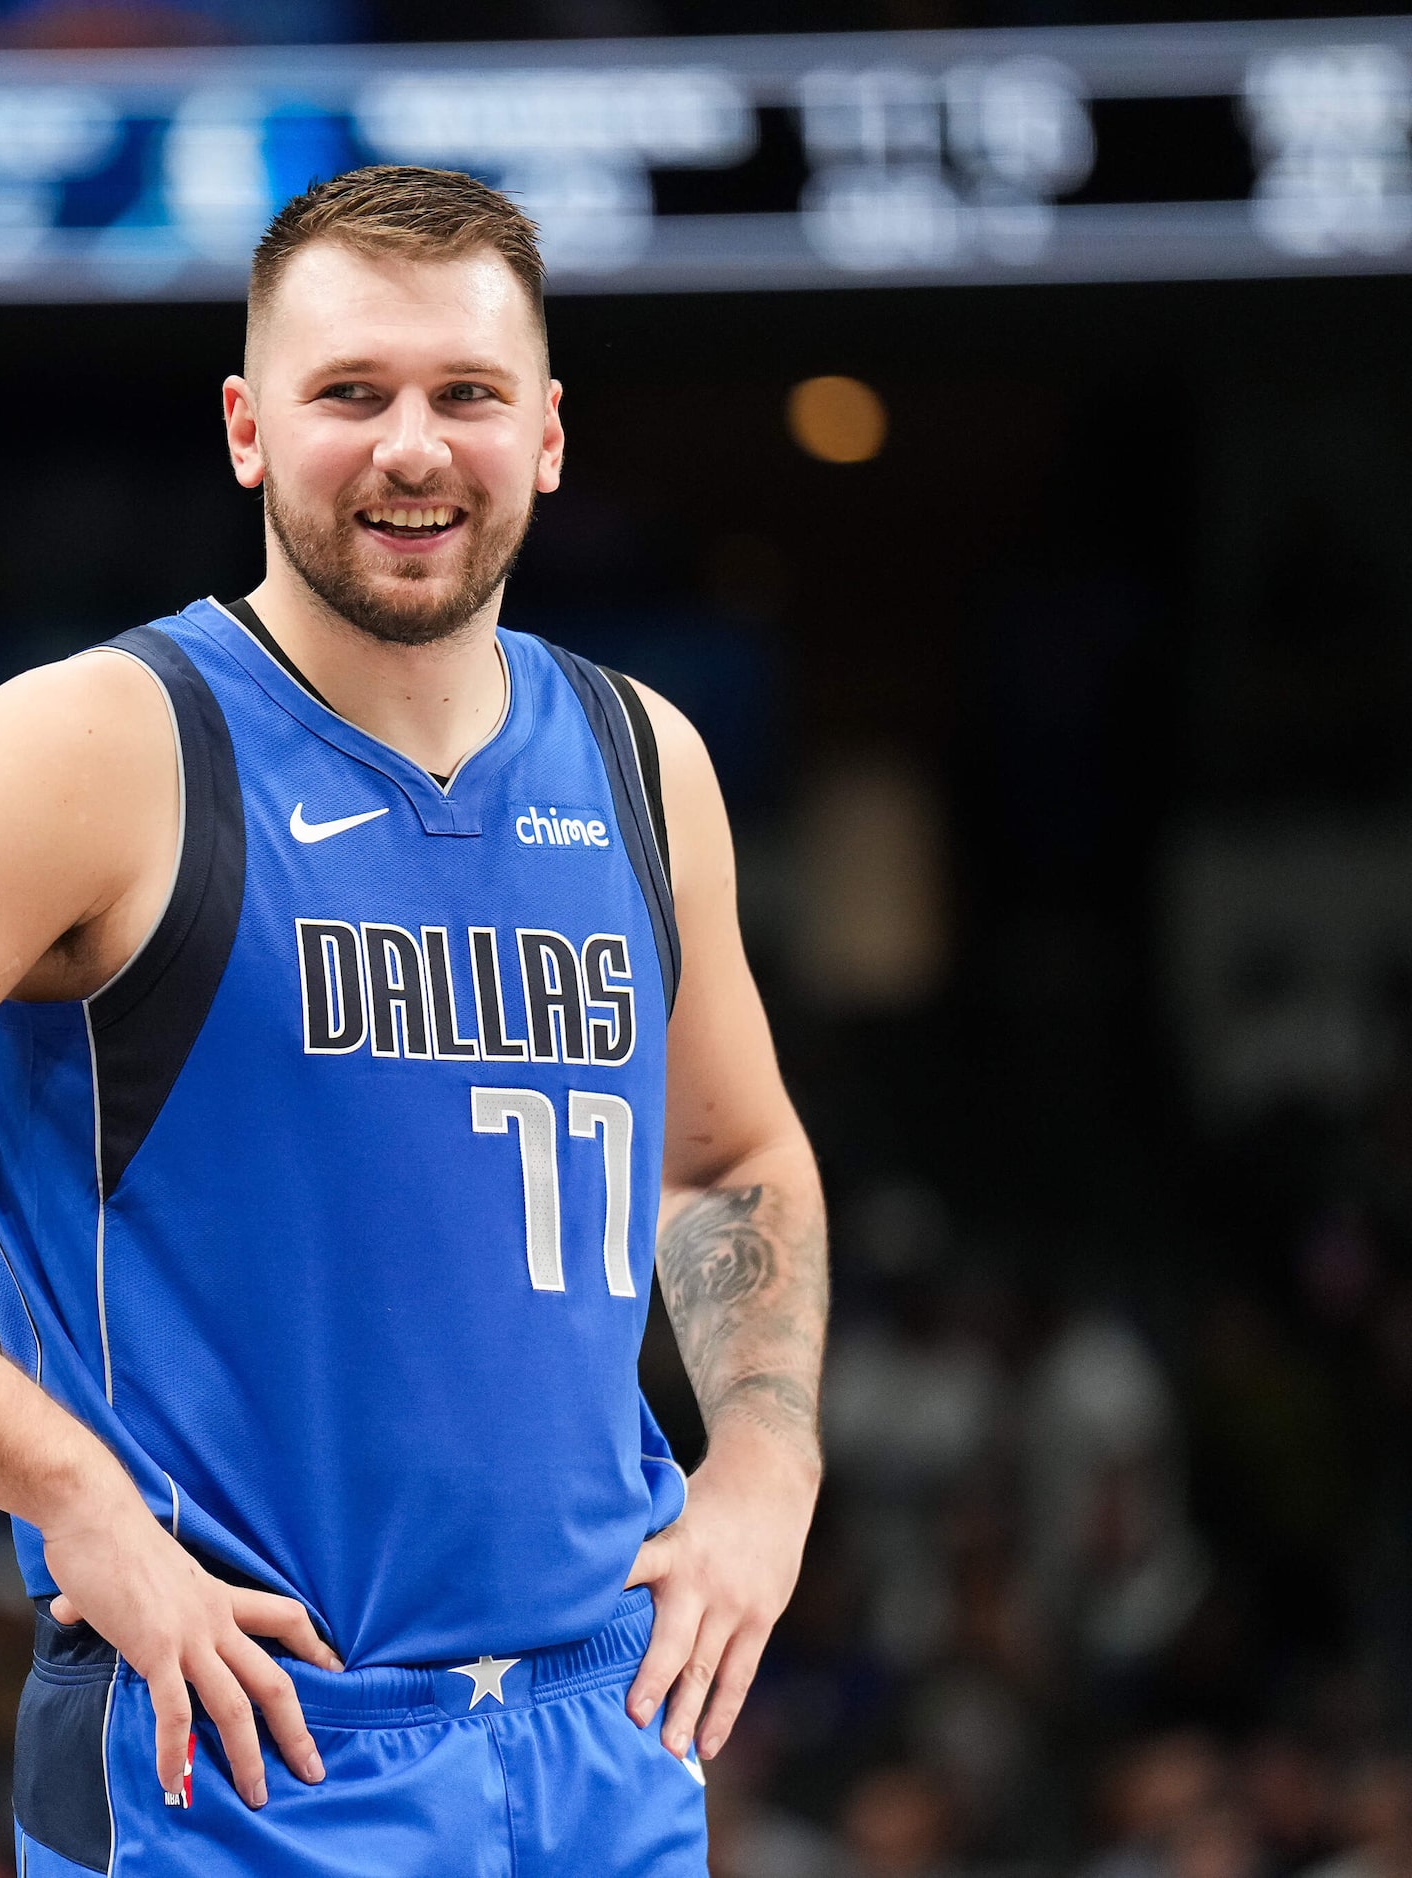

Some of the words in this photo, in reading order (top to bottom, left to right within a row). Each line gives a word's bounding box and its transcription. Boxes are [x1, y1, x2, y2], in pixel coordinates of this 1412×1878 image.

[515, 806, 610, 847] chime
[295, 917, 637, 1067] DALLAS
[470, 1085, 637, 1298] 77
